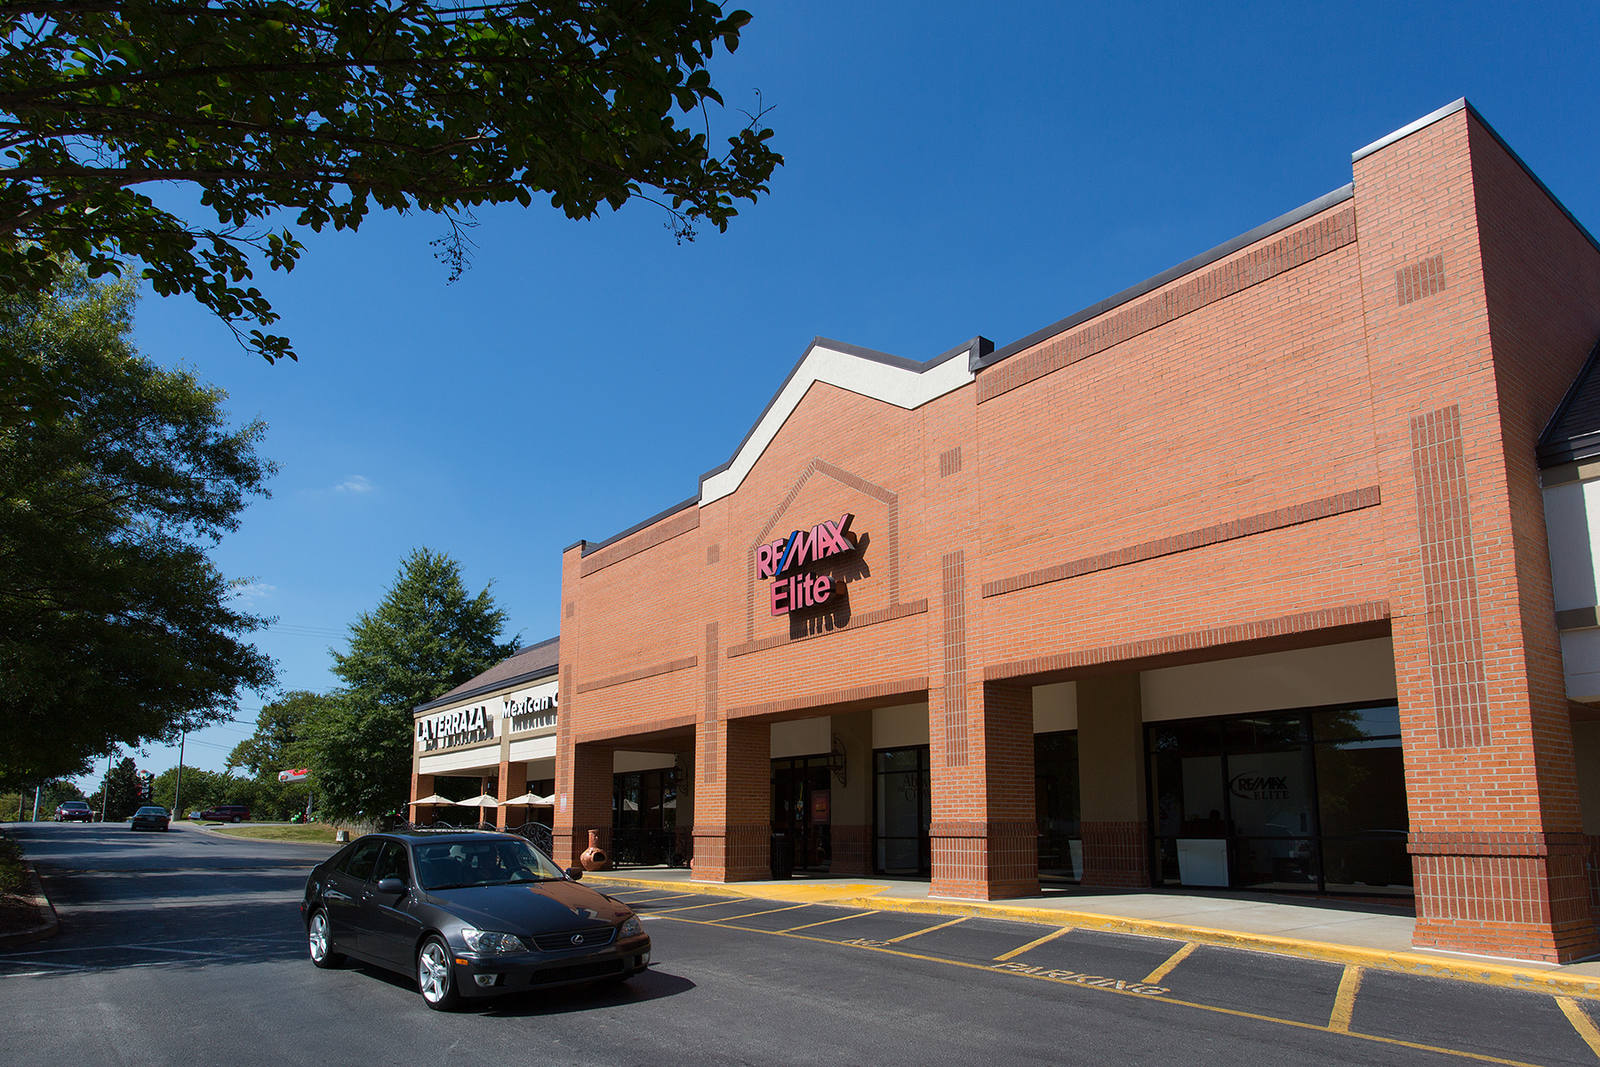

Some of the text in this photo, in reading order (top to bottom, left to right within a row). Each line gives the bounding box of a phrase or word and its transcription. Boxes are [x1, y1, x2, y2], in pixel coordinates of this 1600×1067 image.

[757, 513, 850, 580] RE/MAX
[770, 572, 831, 616] Elite
[417, 719, 430, 742] LA
[431, 706, 485, 740] TERRAZA
[502, 696, 549, 719] Mexican
[1238, 776, 1288, 791] RE/MAX
[1254, 790, 1289, 800] ELITE
[991, 961, 1171, 995] PARKING
